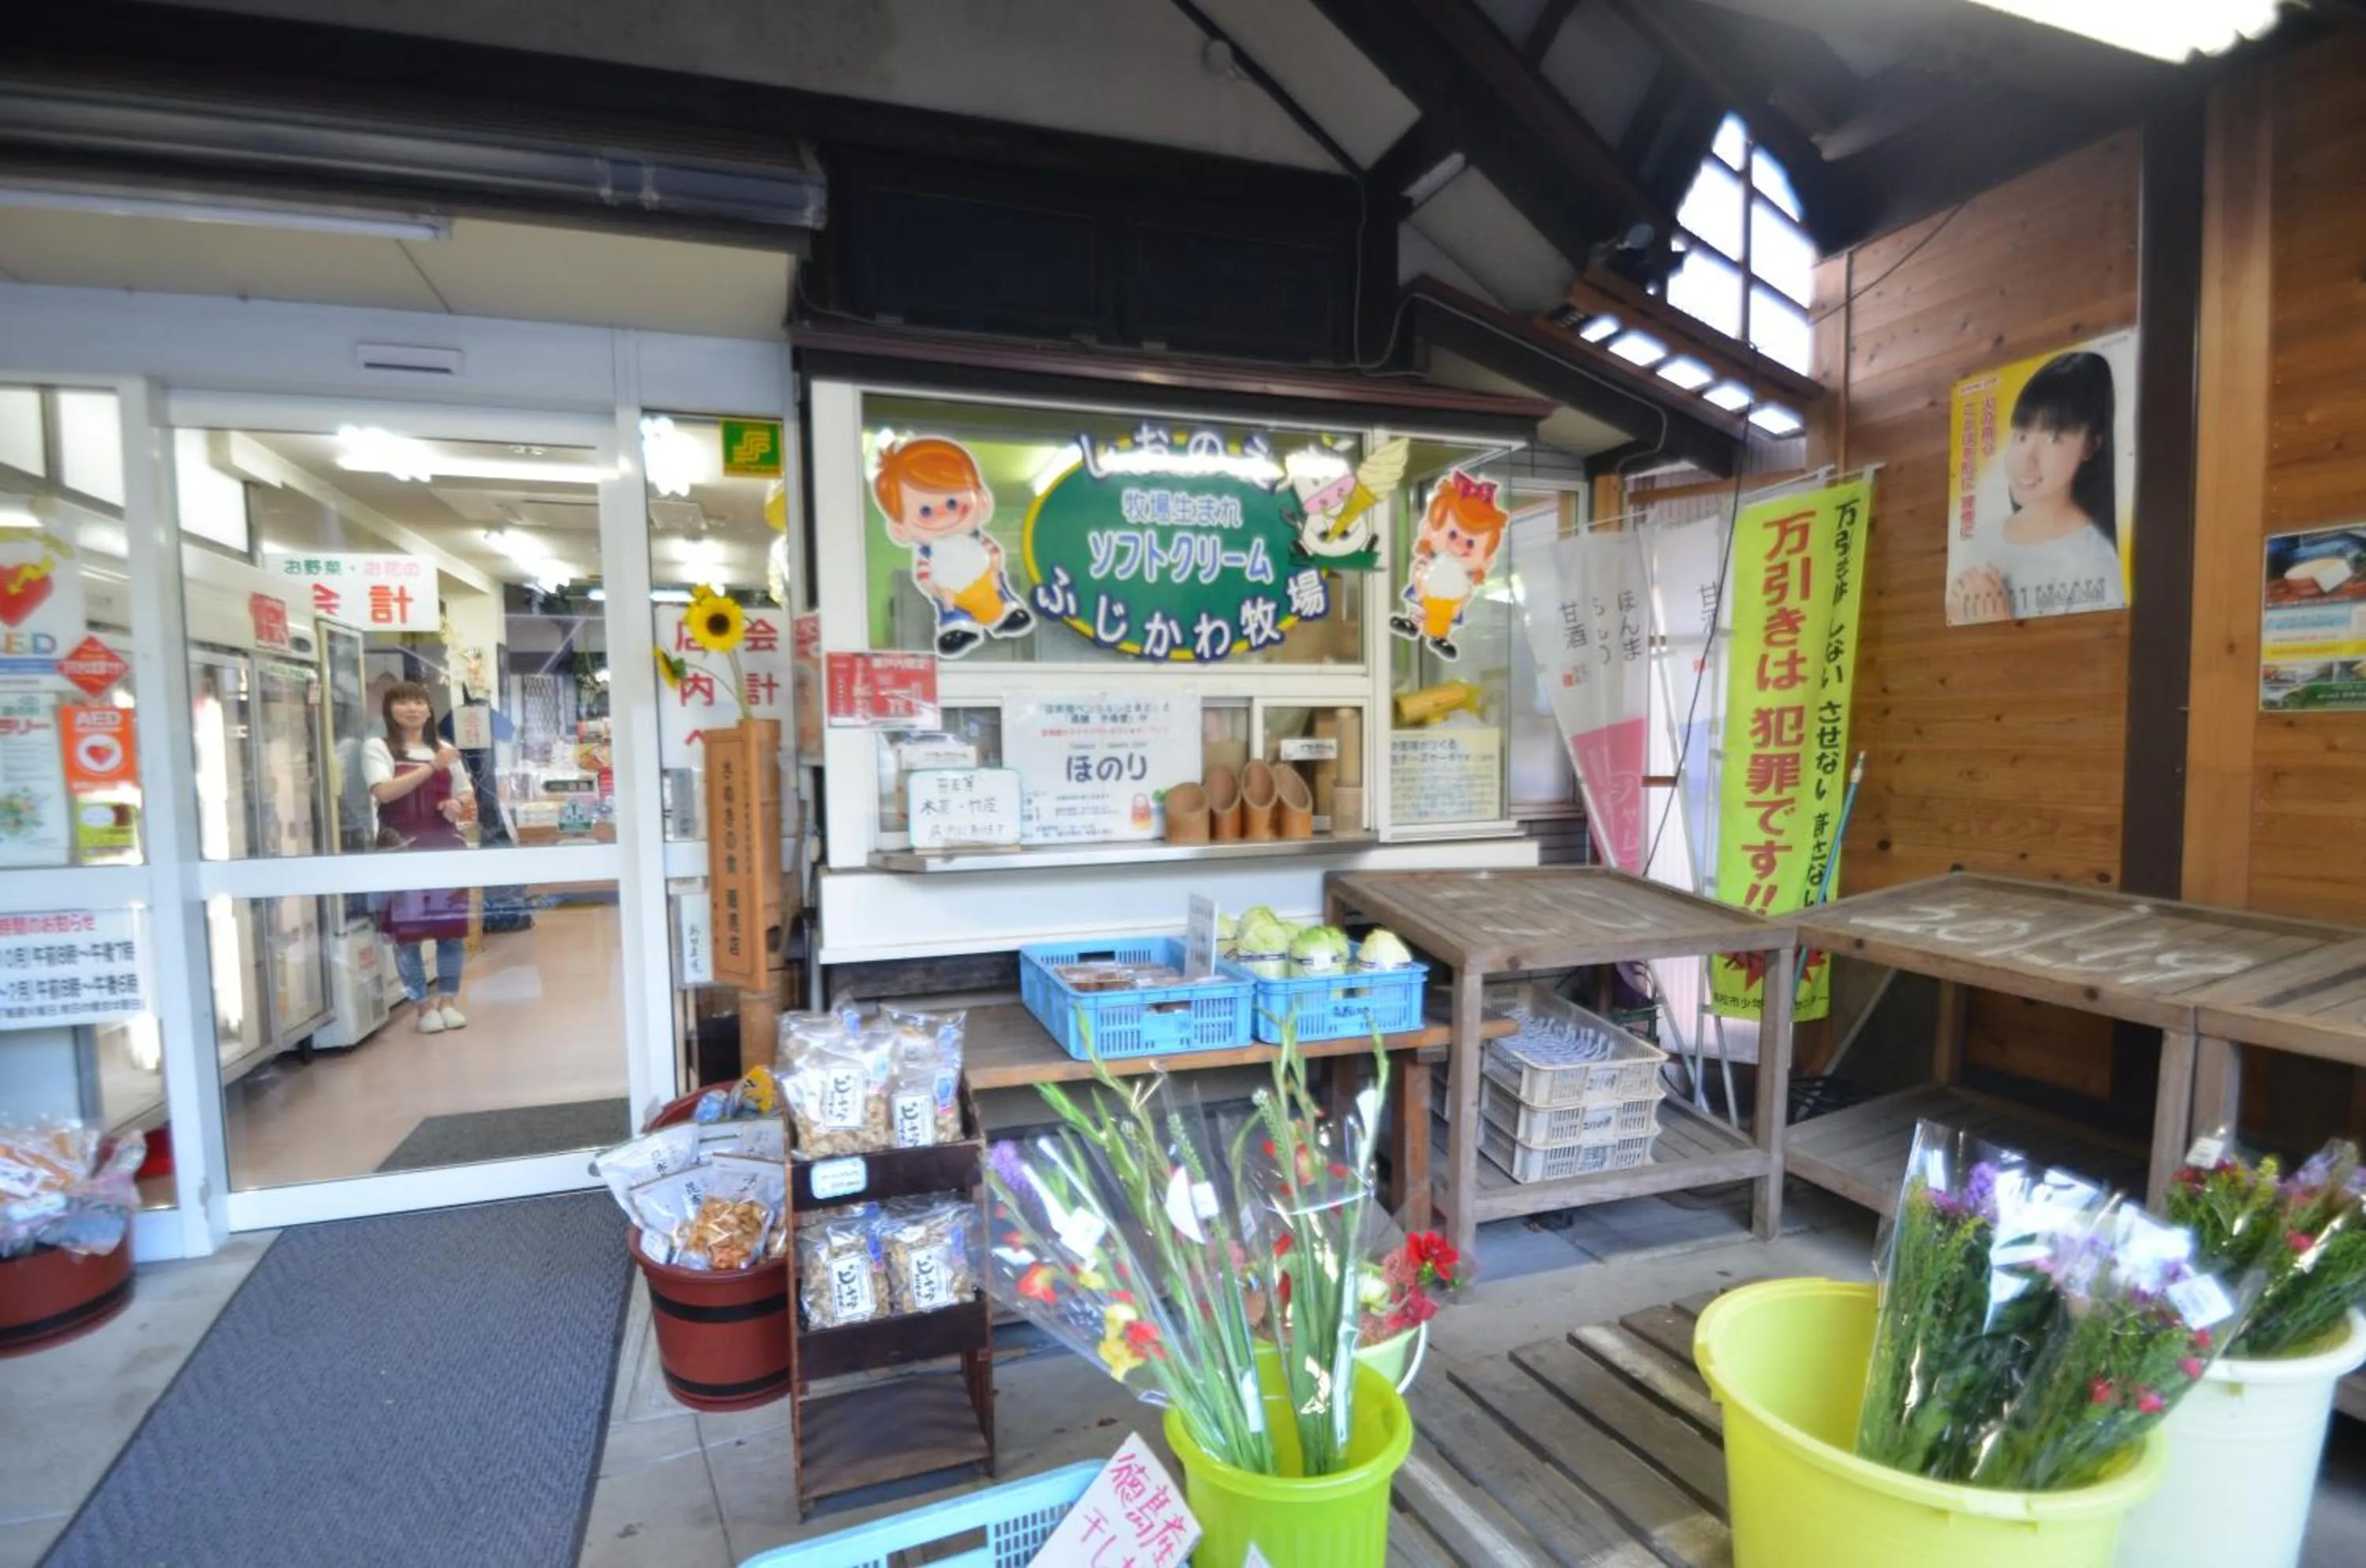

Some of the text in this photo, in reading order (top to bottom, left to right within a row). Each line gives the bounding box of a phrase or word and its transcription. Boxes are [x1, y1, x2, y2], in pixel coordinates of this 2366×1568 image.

[1122, 489, 1242, 528] 牧場生まれ
[1089, 531, 1274, 584] ソフトクリーム
[1036, 567, 1326, 659] ふじかわ牧場
[1756, 510, 1817, 693] 万引きは
[744, 618, 780, 706] 会計
[1066, 752, 1148, 782] ほのり
